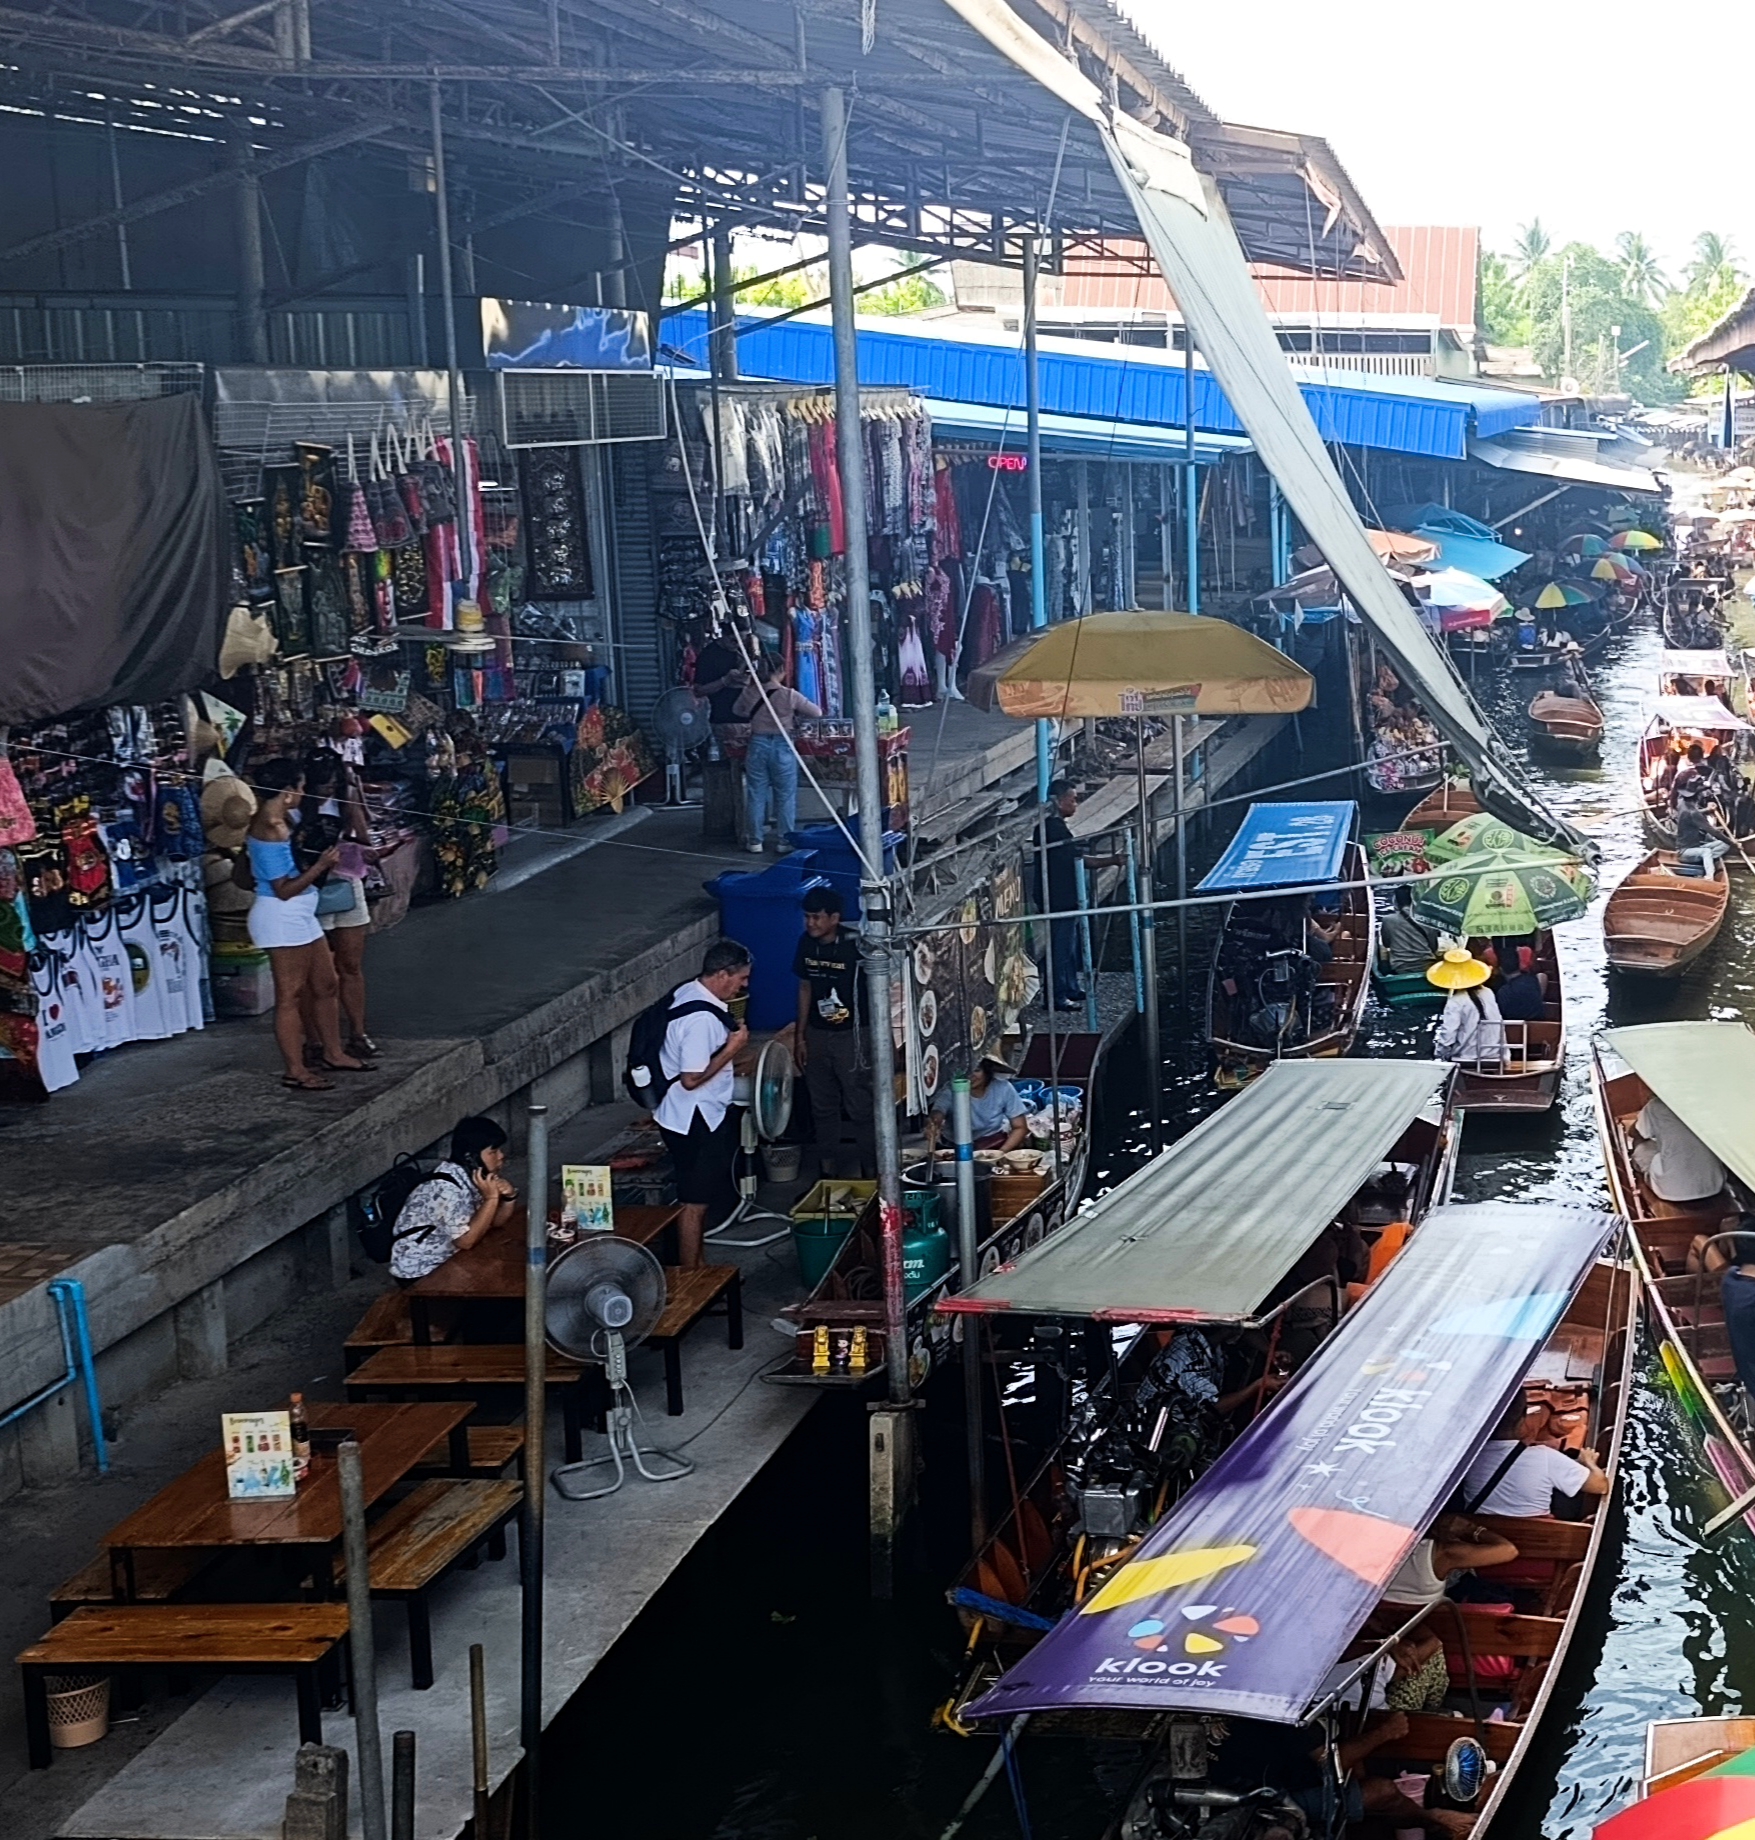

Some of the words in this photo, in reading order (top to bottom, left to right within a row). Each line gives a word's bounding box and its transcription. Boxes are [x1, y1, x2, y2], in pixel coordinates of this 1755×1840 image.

[988, 456, 1027, 470] OPEN
[1333, 1387, 1433, 1455] klook
[1095, 1657, 1227, 1677] klook
[1127, 1676, 1169, 1684] world
[1172, 1677, 1189, 1685] of
[1189, 1678, 1217, 1688] joy
